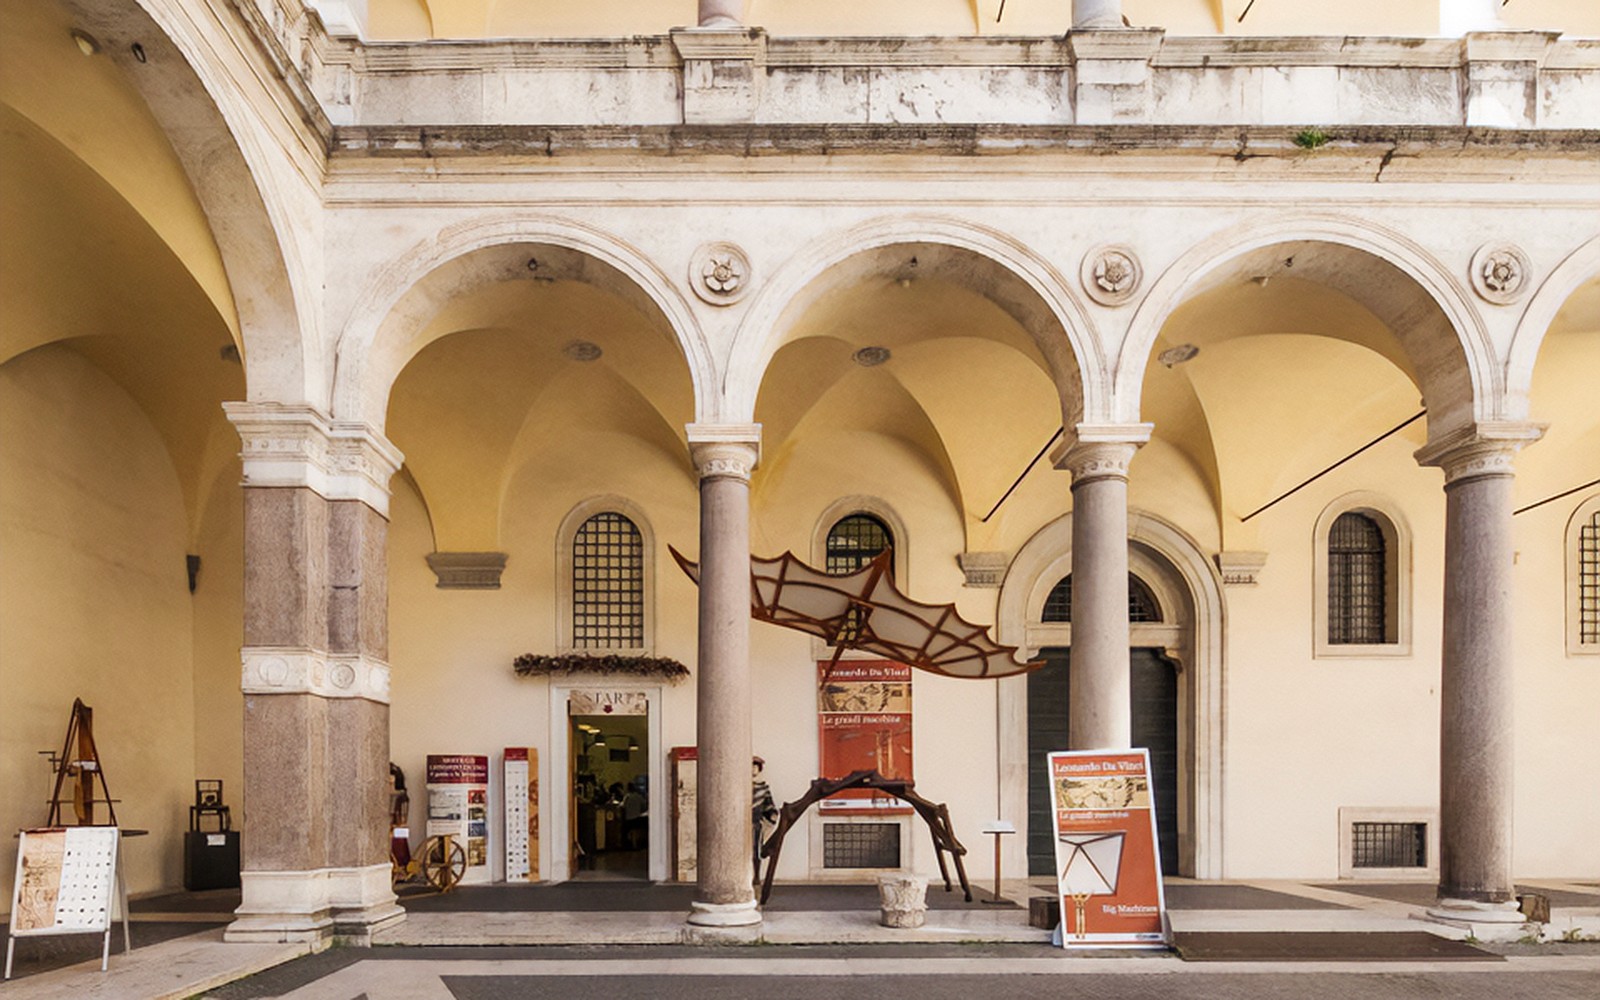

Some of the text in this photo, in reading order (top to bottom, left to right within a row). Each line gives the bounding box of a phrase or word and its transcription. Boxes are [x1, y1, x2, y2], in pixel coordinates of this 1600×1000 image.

[884, 668, 909, 676] Vinci
[1056, 761, 1143, 773] Leonardo Da Vinci
[1103, 904, 1157, 914] Big Machines
